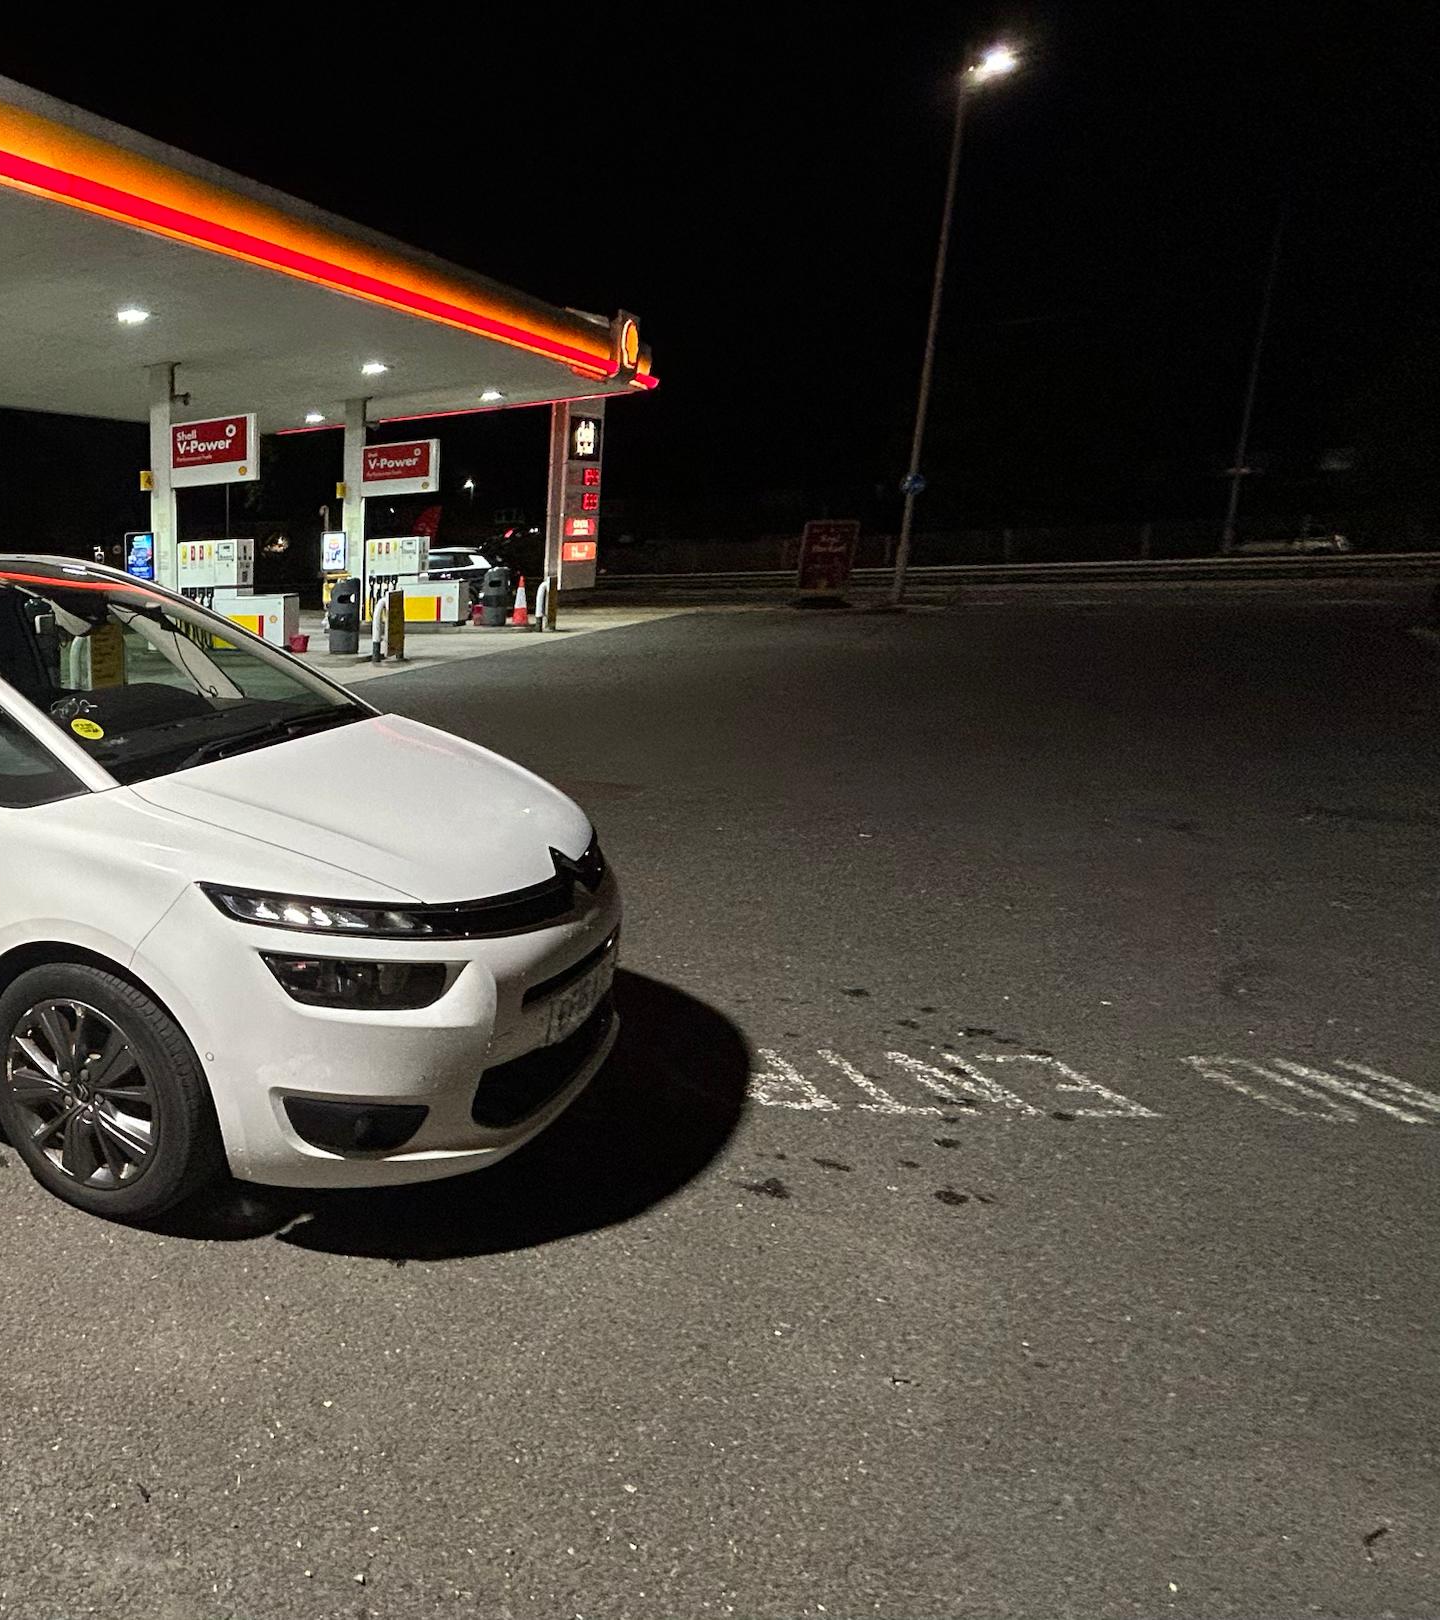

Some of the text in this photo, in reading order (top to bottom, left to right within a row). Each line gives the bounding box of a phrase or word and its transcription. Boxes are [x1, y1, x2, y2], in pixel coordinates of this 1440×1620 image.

[176, 430, 197, 441] Shell
[177, 439, 232, 454] V-Power
[368, 457, 419, 470] V-Power
[748, 1048, 1161, 1118] ENTR
